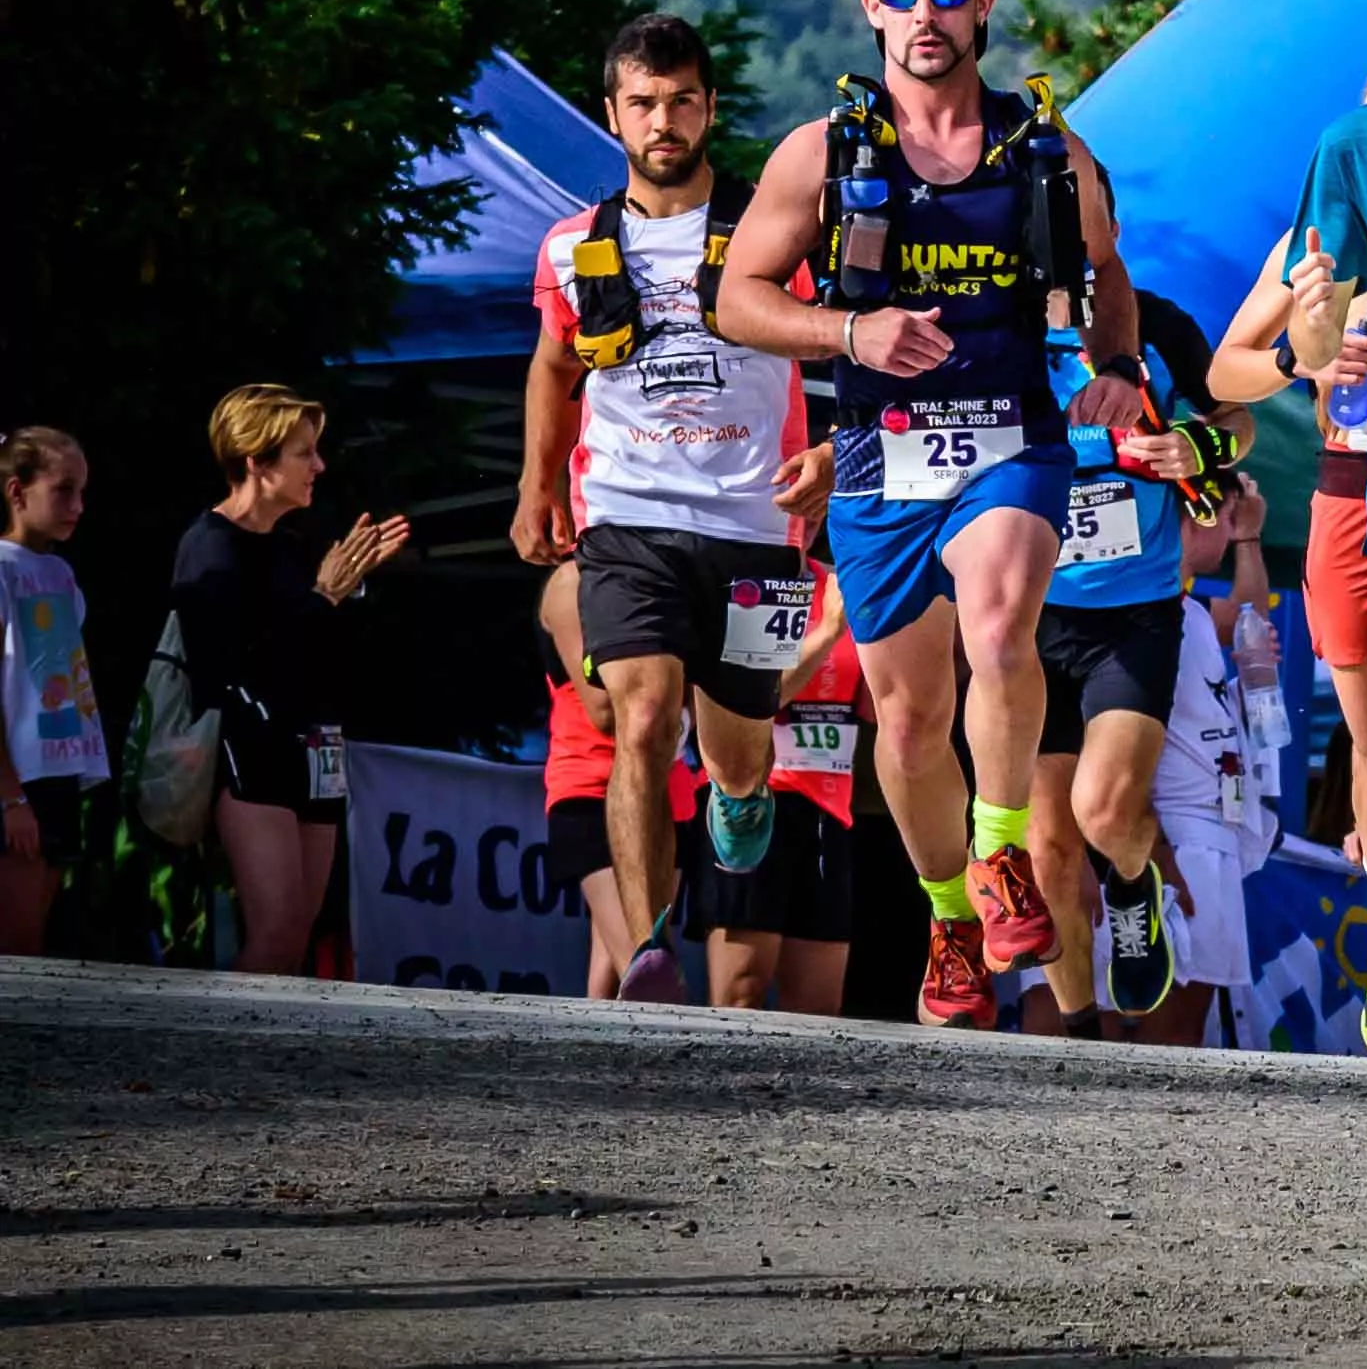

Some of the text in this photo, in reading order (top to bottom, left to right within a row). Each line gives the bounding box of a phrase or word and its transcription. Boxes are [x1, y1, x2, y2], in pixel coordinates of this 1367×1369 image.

[926, 414, 998, 427] TRAIL 2023
[923, 431, 978, 468] 25
[763, 609, 808, 641] 46
[790, 725, 841, 751] 119
[380, 812, 456, 906] La
